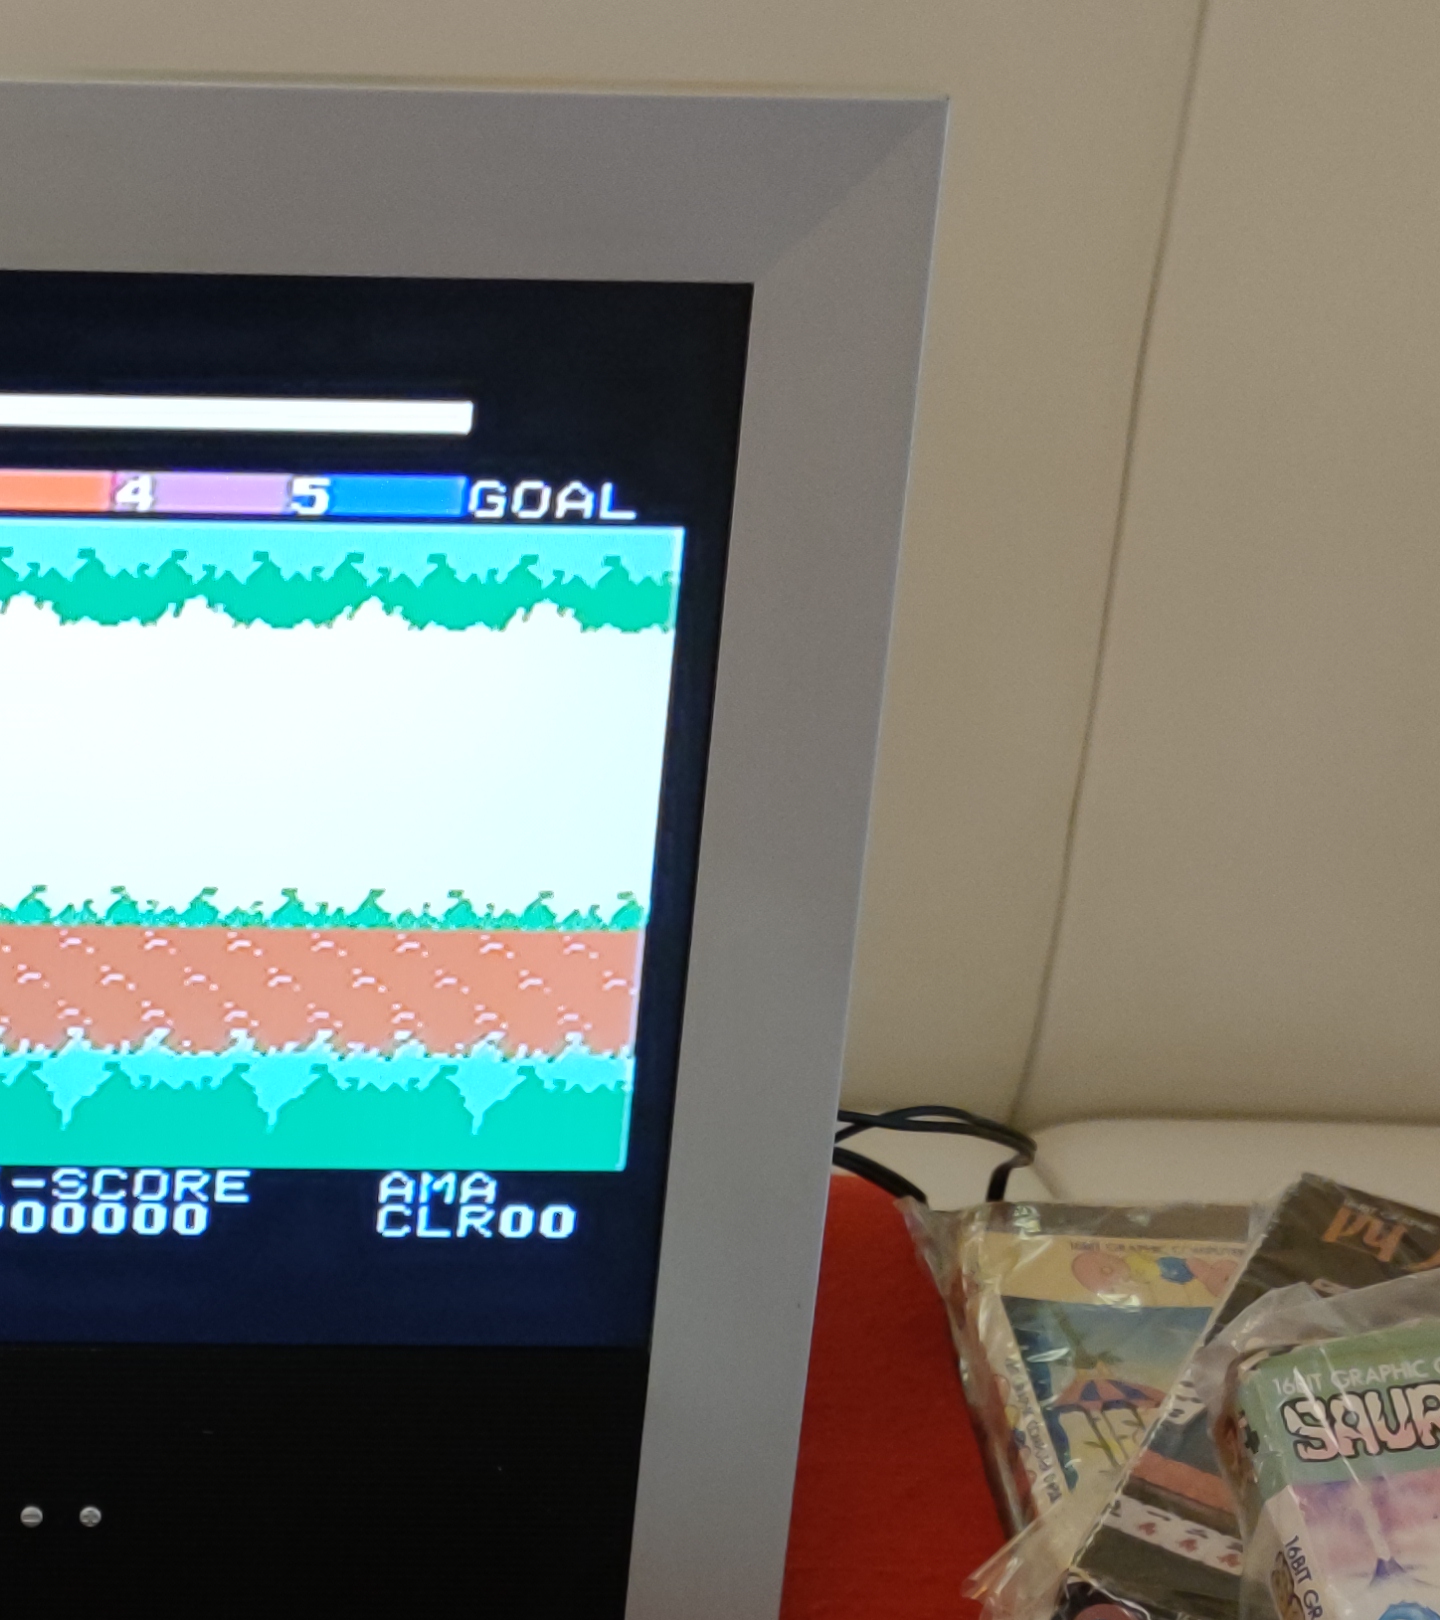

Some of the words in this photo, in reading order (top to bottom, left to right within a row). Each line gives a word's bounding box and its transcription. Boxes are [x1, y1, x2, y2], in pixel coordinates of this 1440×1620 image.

[115, 474, 153, 512] 4
[291, 477, 332, 515] 5
[468, 481, 637, 520] GOAL
[377, 1170, 498, 1204] AMA
[1331, 1358, 1429, 1390] GRAPHIC
[1283, 1534, 1314, 1584] 16BIT
